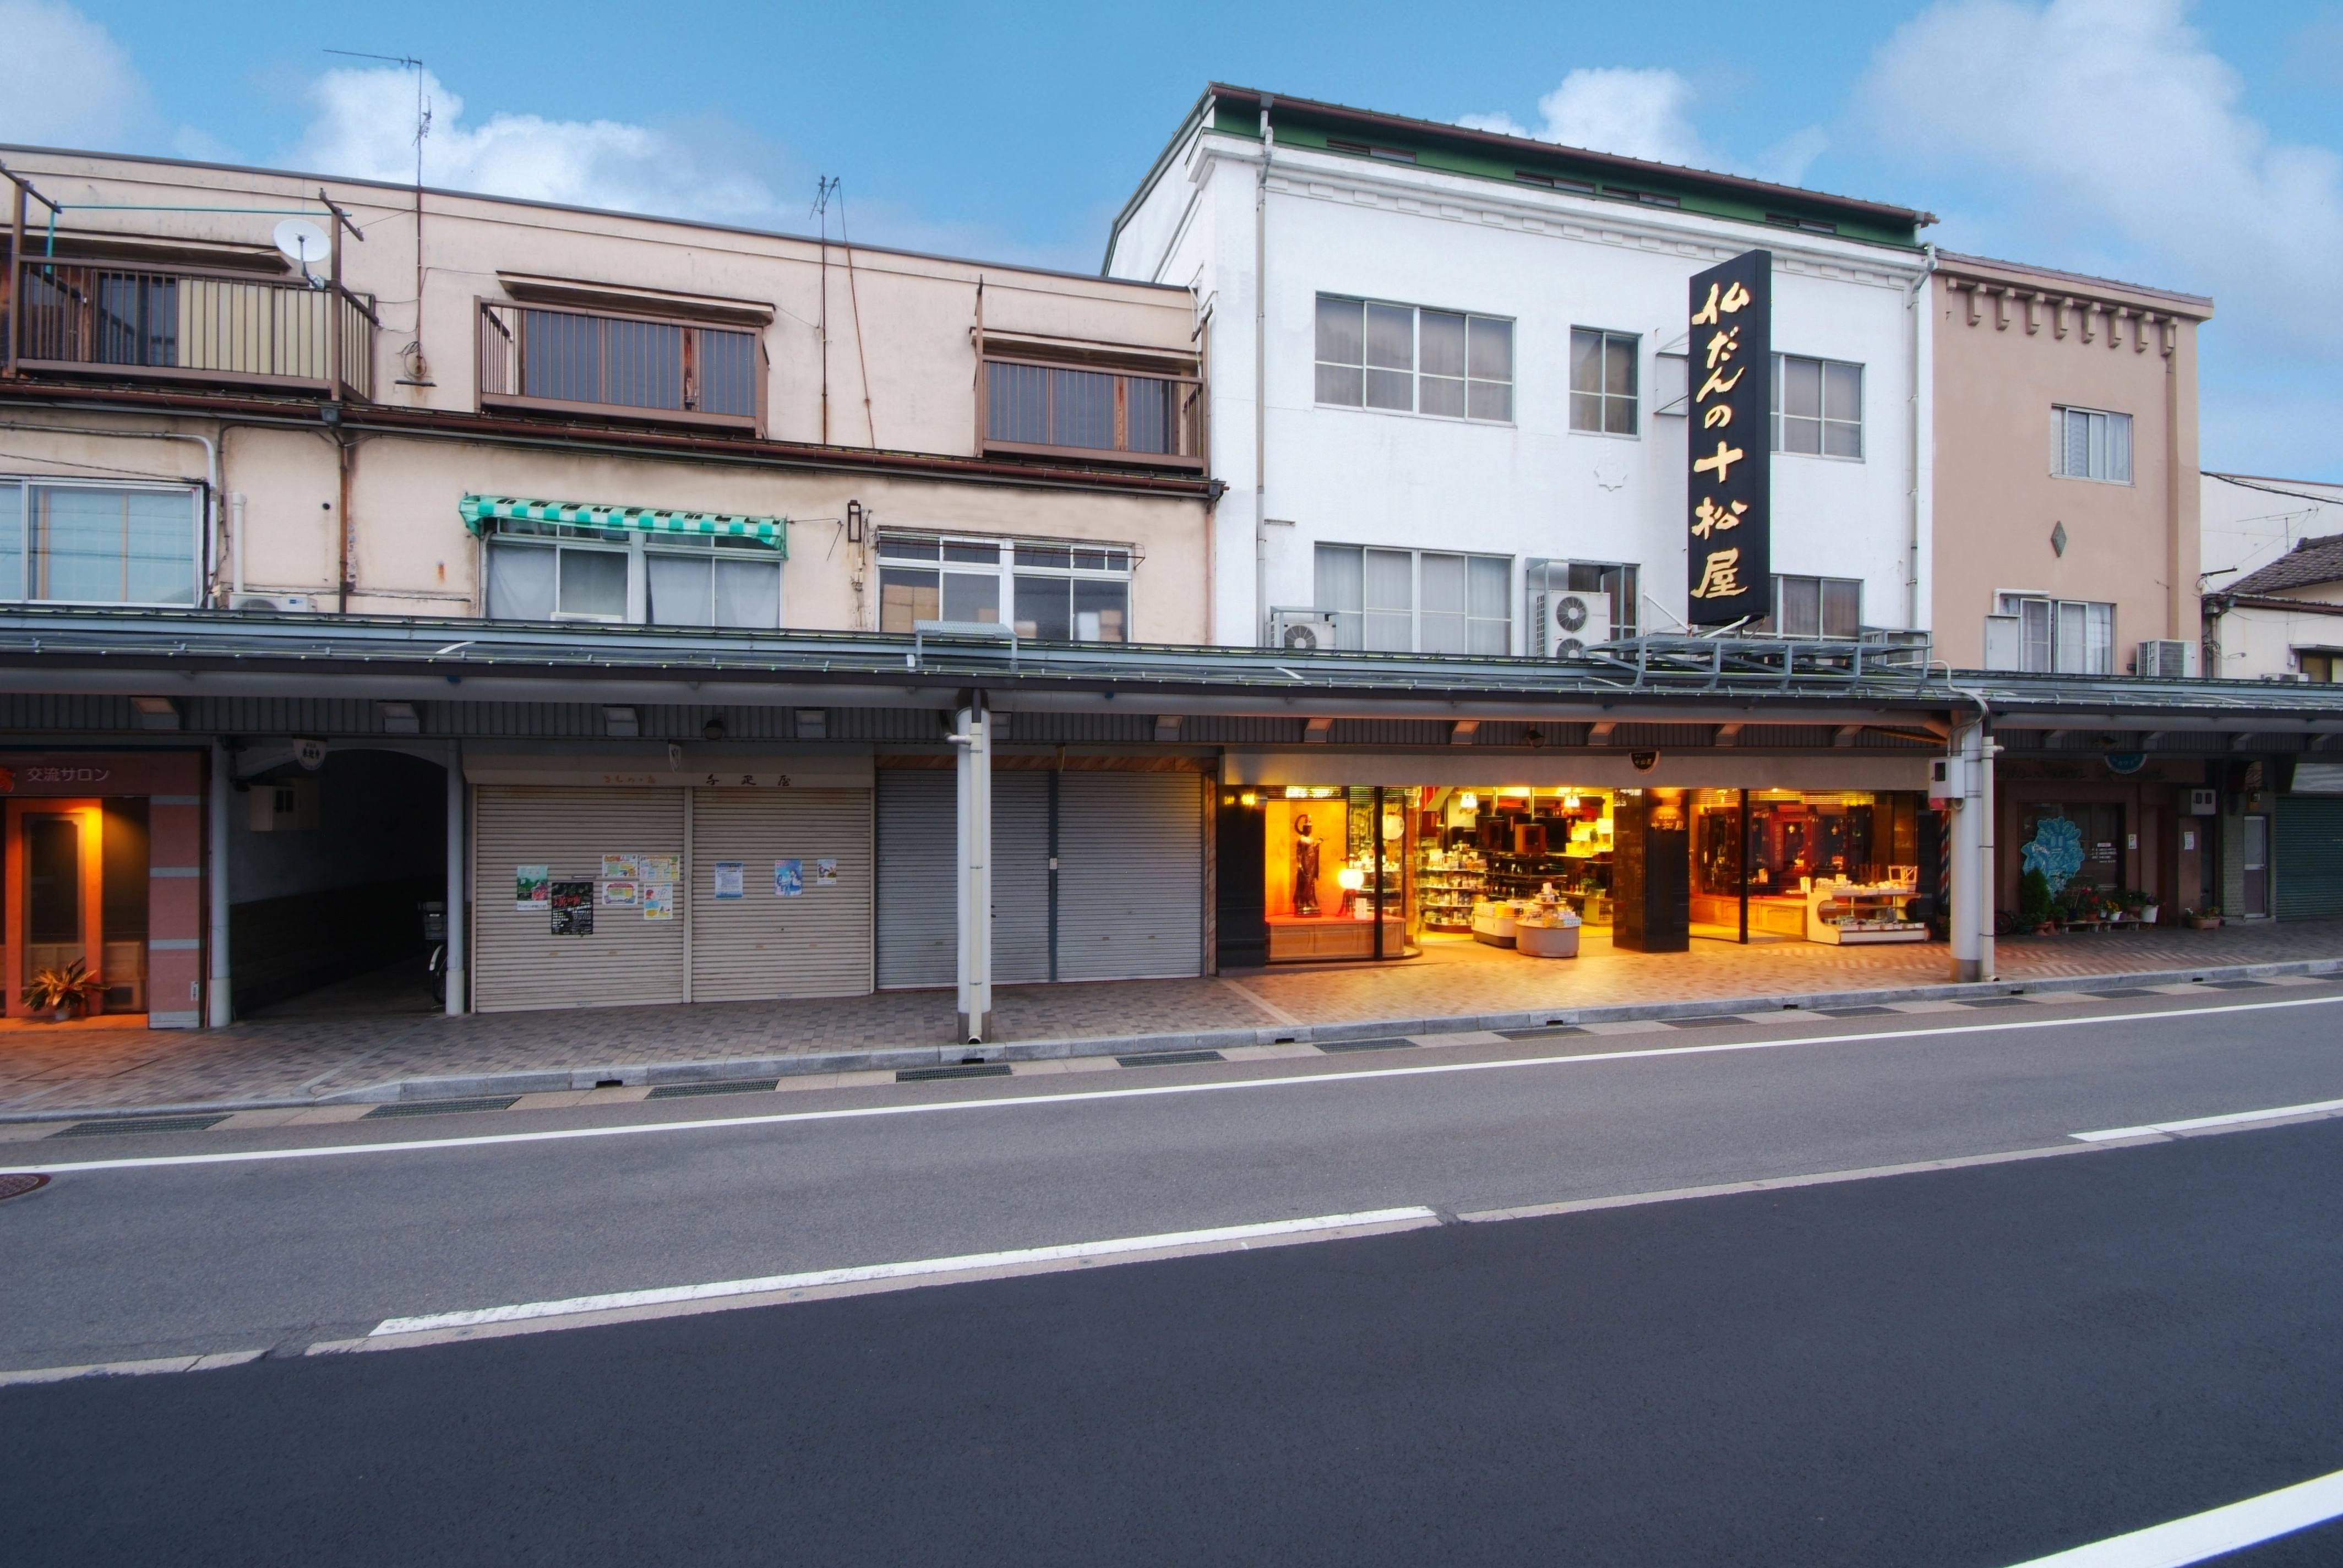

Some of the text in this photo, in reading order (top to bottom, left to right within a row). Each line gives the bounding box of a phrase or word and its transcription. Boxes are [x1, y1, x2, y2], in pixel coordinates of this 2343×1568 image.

[1691, 281, 1750, 599] 仏だんの十松屋
[26, 767, 111, 782] 交流サロン
